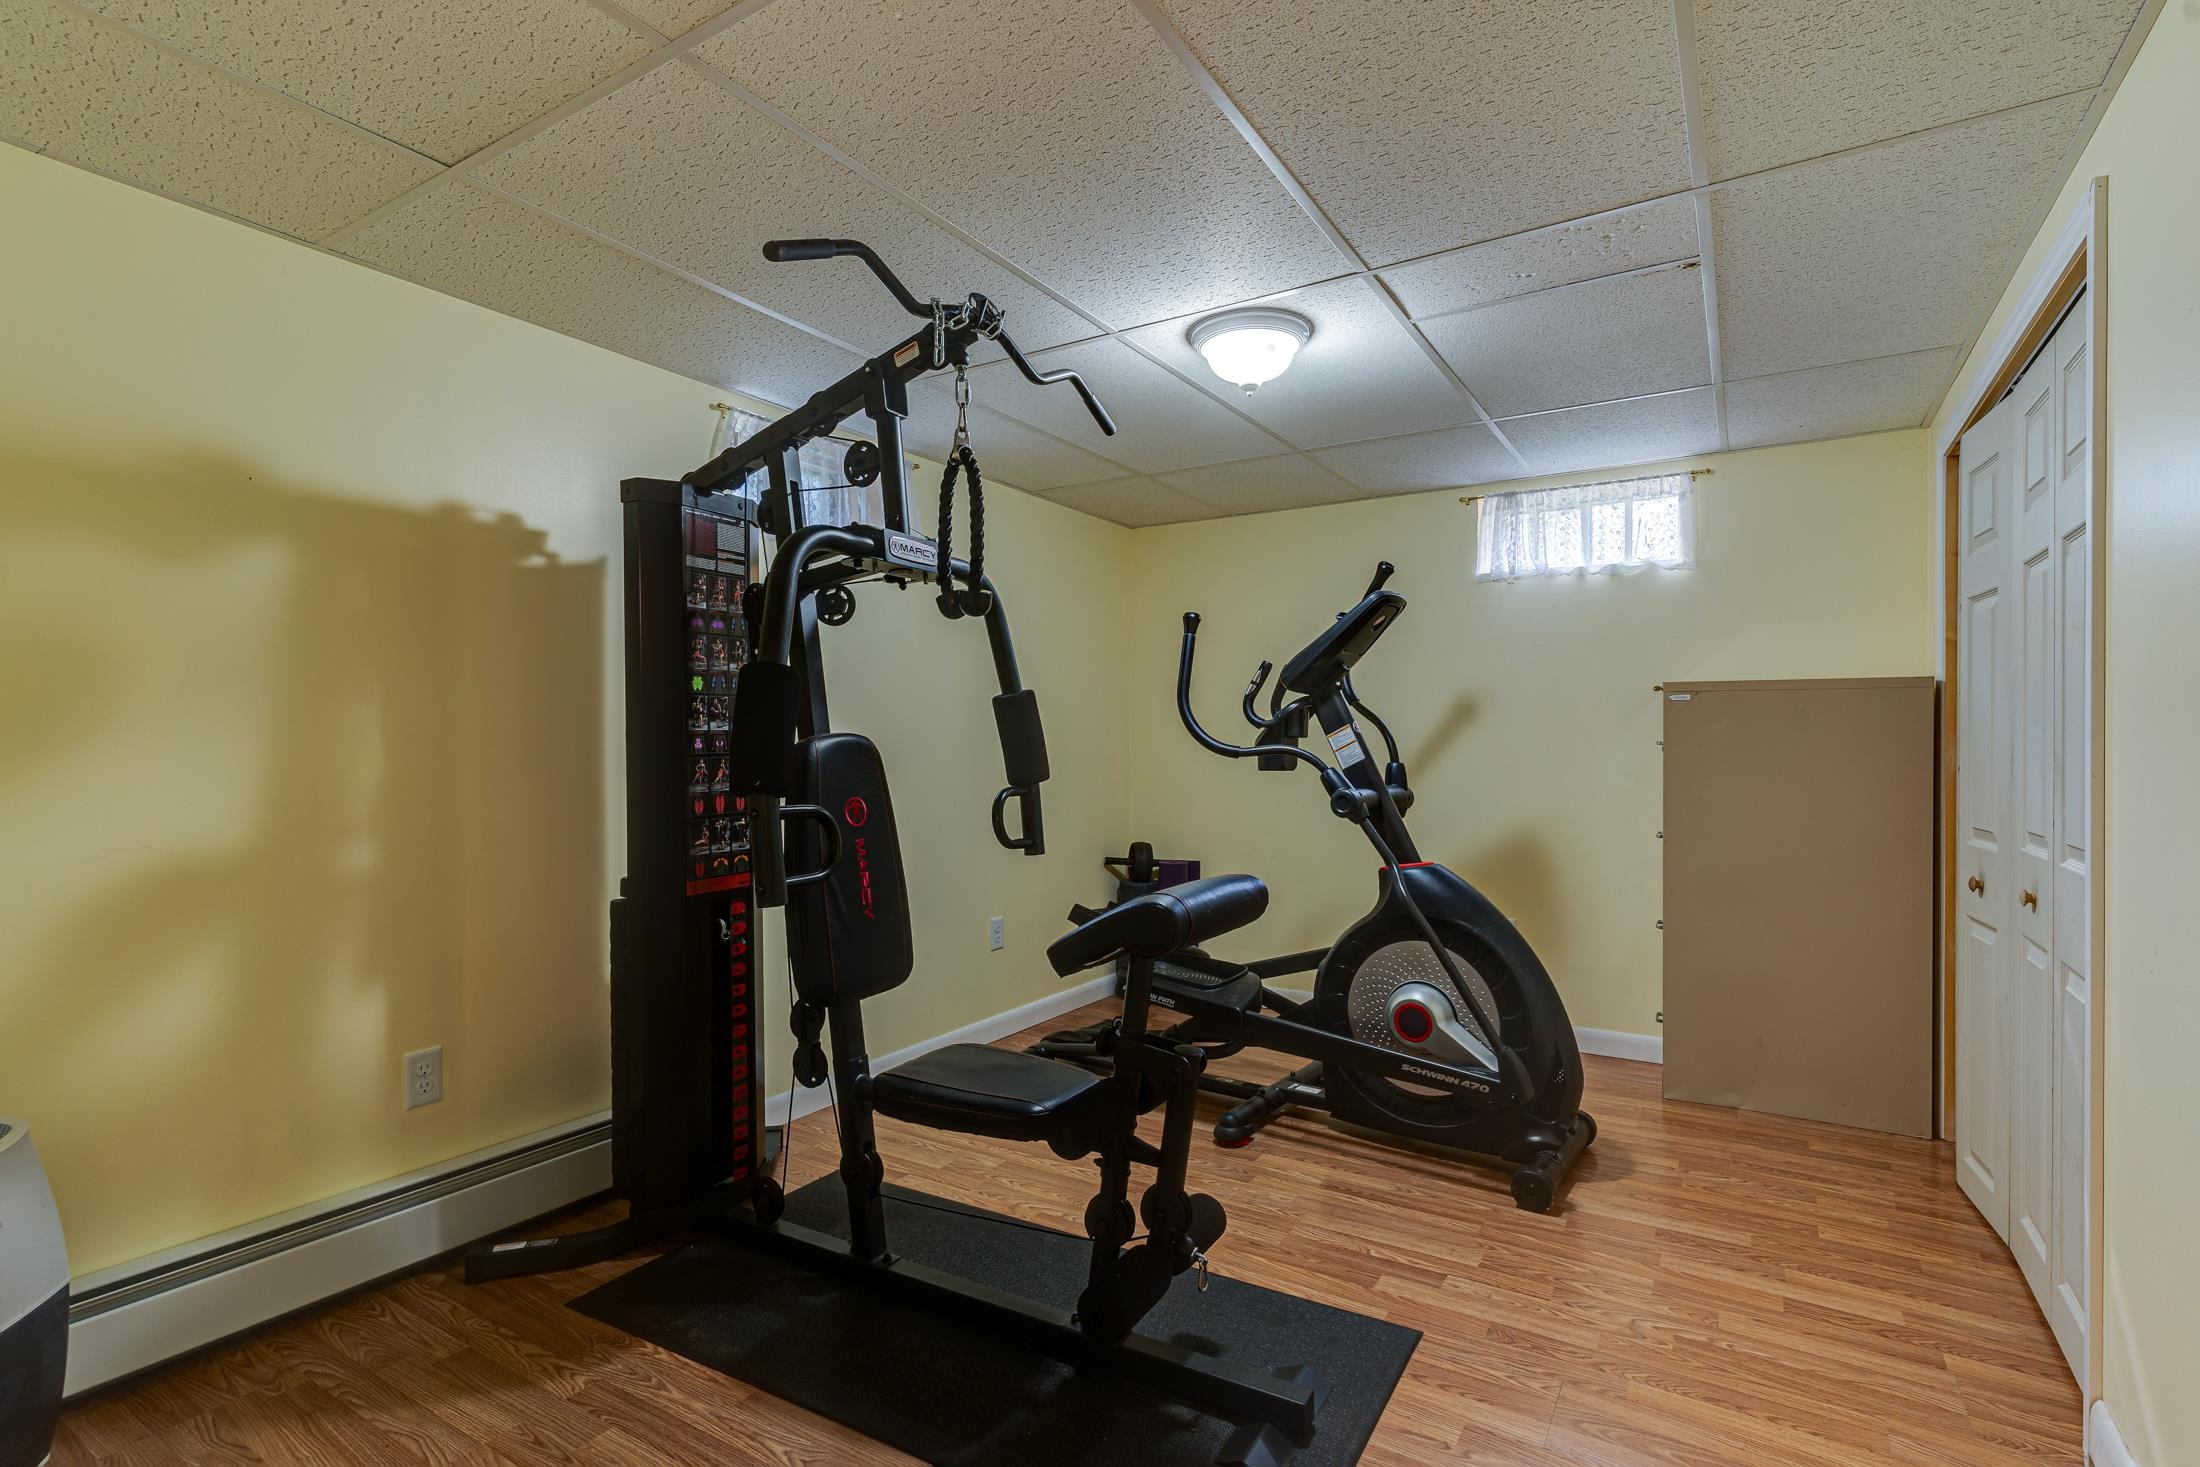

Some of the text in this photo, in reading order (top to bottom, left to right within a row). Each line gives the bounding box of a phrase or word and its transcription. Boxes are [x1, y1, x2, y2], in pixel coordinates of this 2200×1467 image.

[900, 543, 936, 559] MARCY
[855, 838, 875, 919] MARCY
[1401, 1063, 1490, 1093] SCHWINN 470
